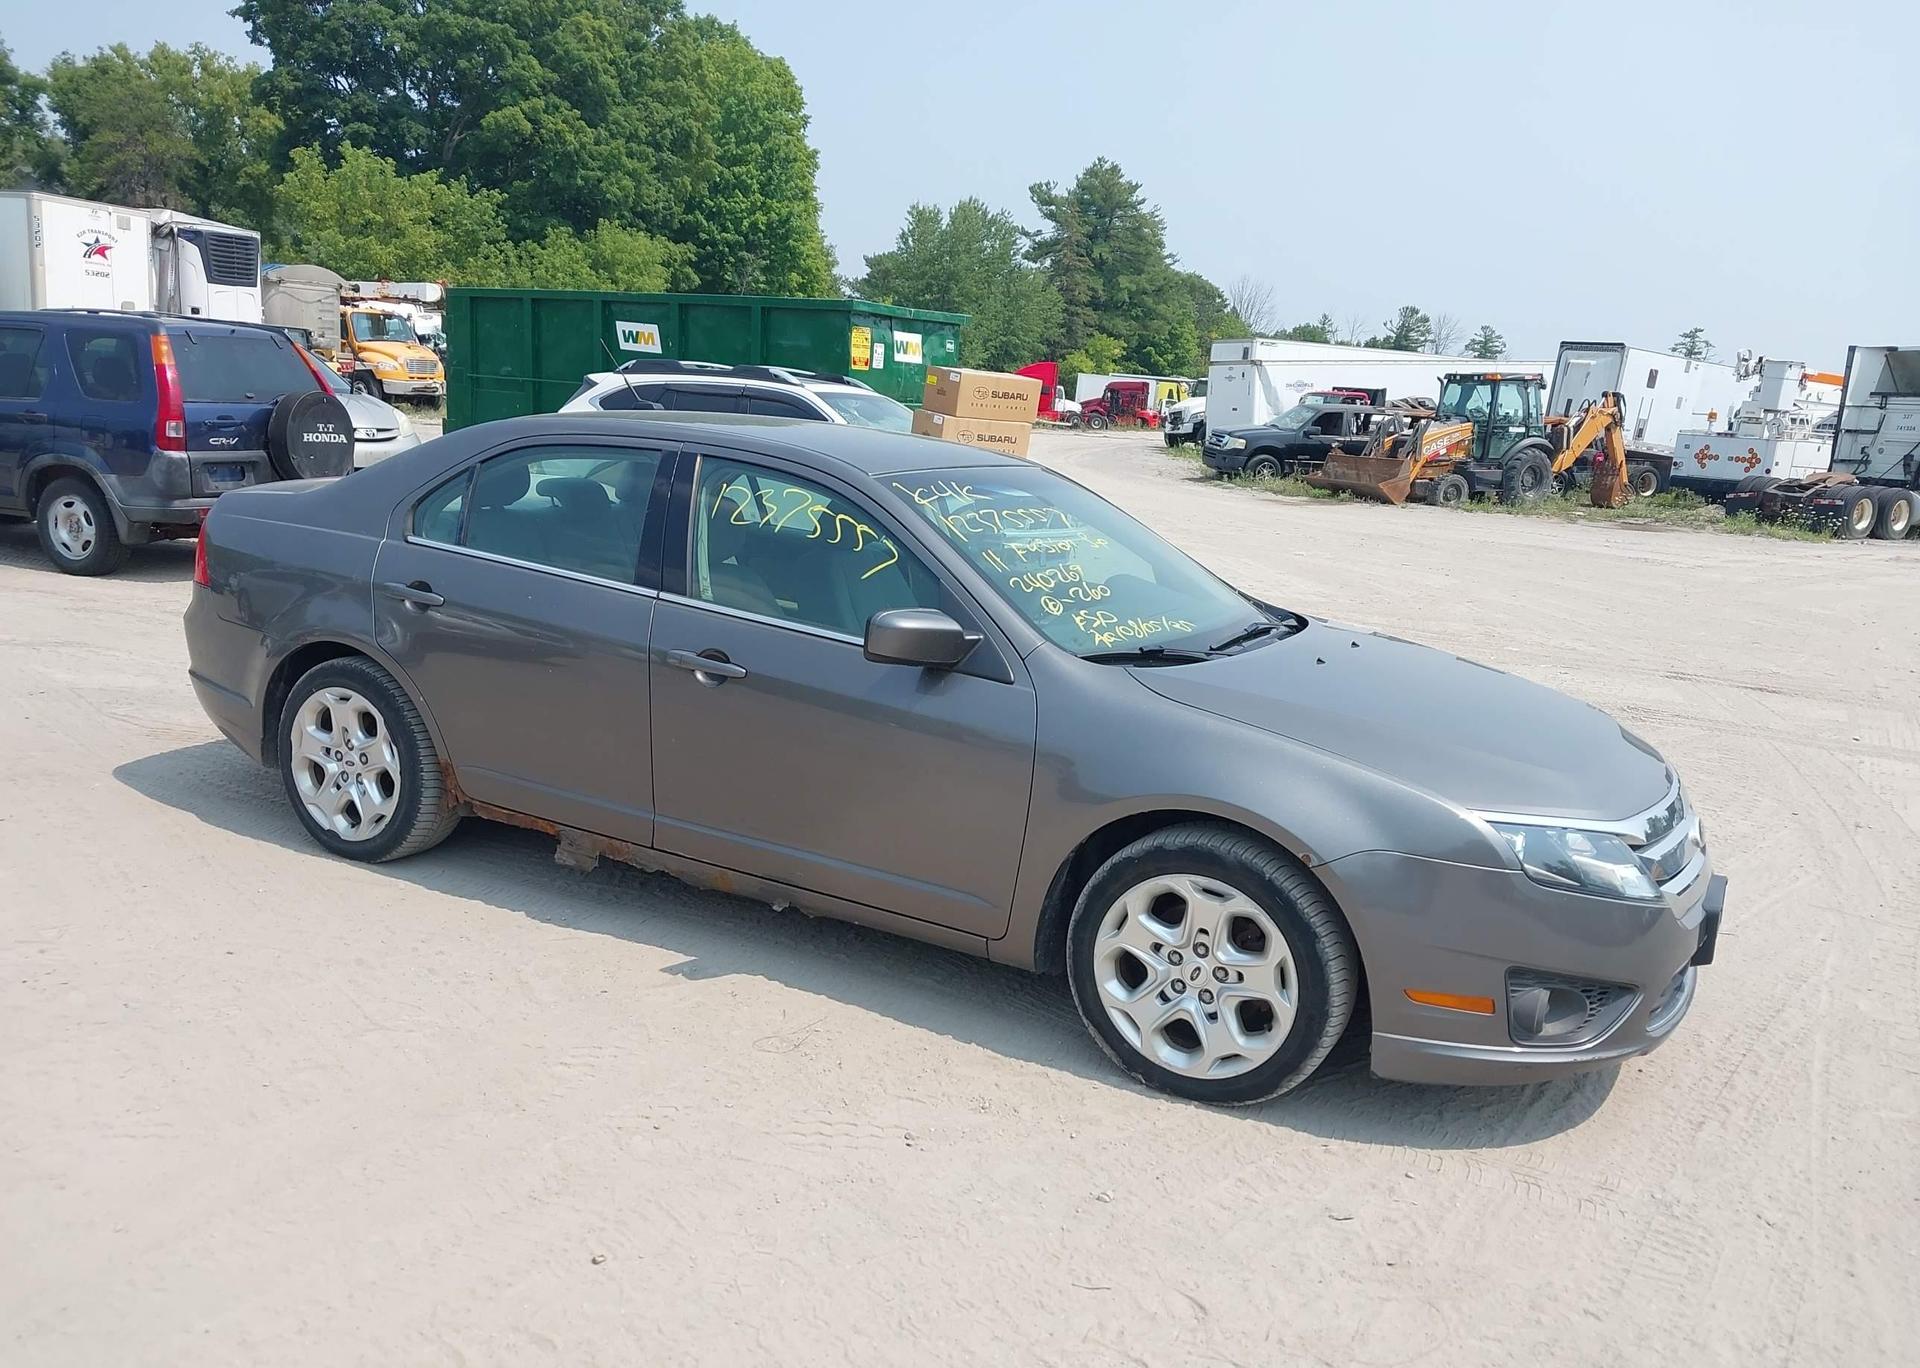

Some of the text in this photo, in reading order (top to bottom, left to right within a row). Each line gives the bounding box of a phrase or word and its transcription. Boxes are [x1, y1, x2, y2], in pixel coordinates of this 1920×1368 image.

[621, 329, 655, 346] WM
[895, 340, 921, 357] WM
[991, 390, 1029, 401] SUBARU
[208, 437, 240, 446] CR-V
[302, 433, 348, 444] HONDA
[976, 433, 1017, 445] SUBARU
[1423, 435, 1451, 455] CASE
